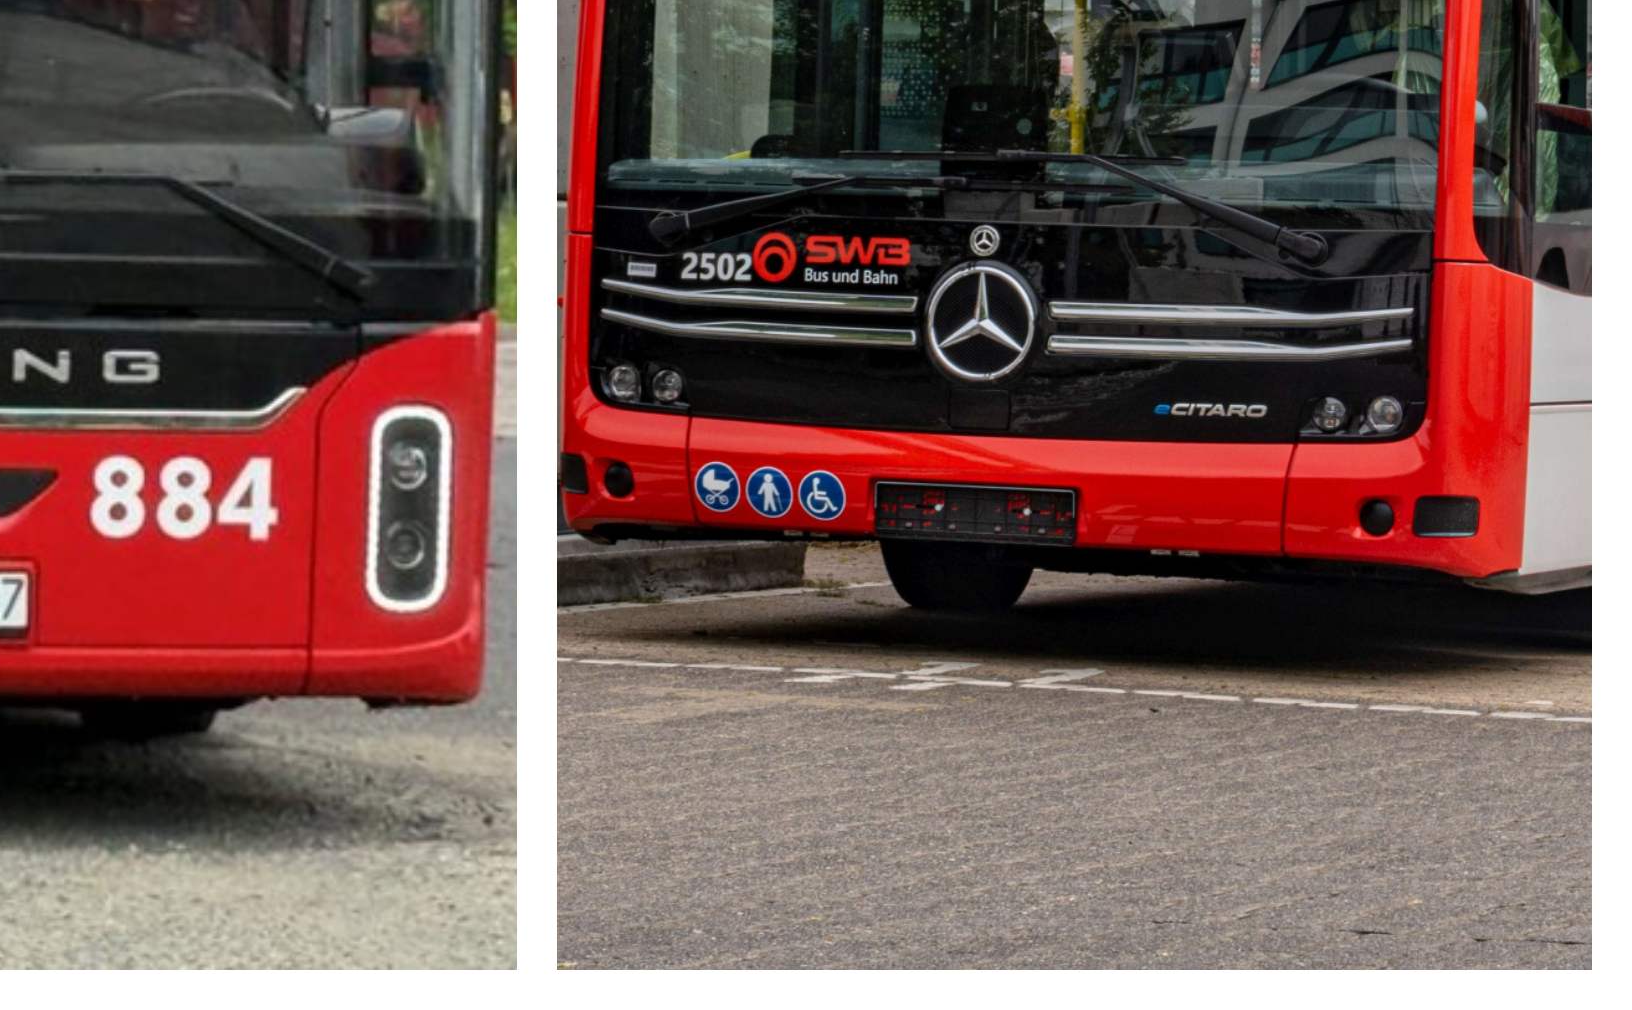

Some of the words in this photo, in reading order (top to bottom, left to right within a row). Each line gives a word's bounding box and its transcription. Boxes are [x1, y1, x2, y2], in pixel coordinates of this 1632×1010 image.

[806, 234, 912, 266] SWB
[680, 251, 752, 281] 2502
[804, 267, 829, 283] Bus
[832, 268, 860, 284] und
[863, 269, 899, 285] Bahn
[1153, 402, 1268, 418] eCITARO
[88, 453, 280, 542] 884
